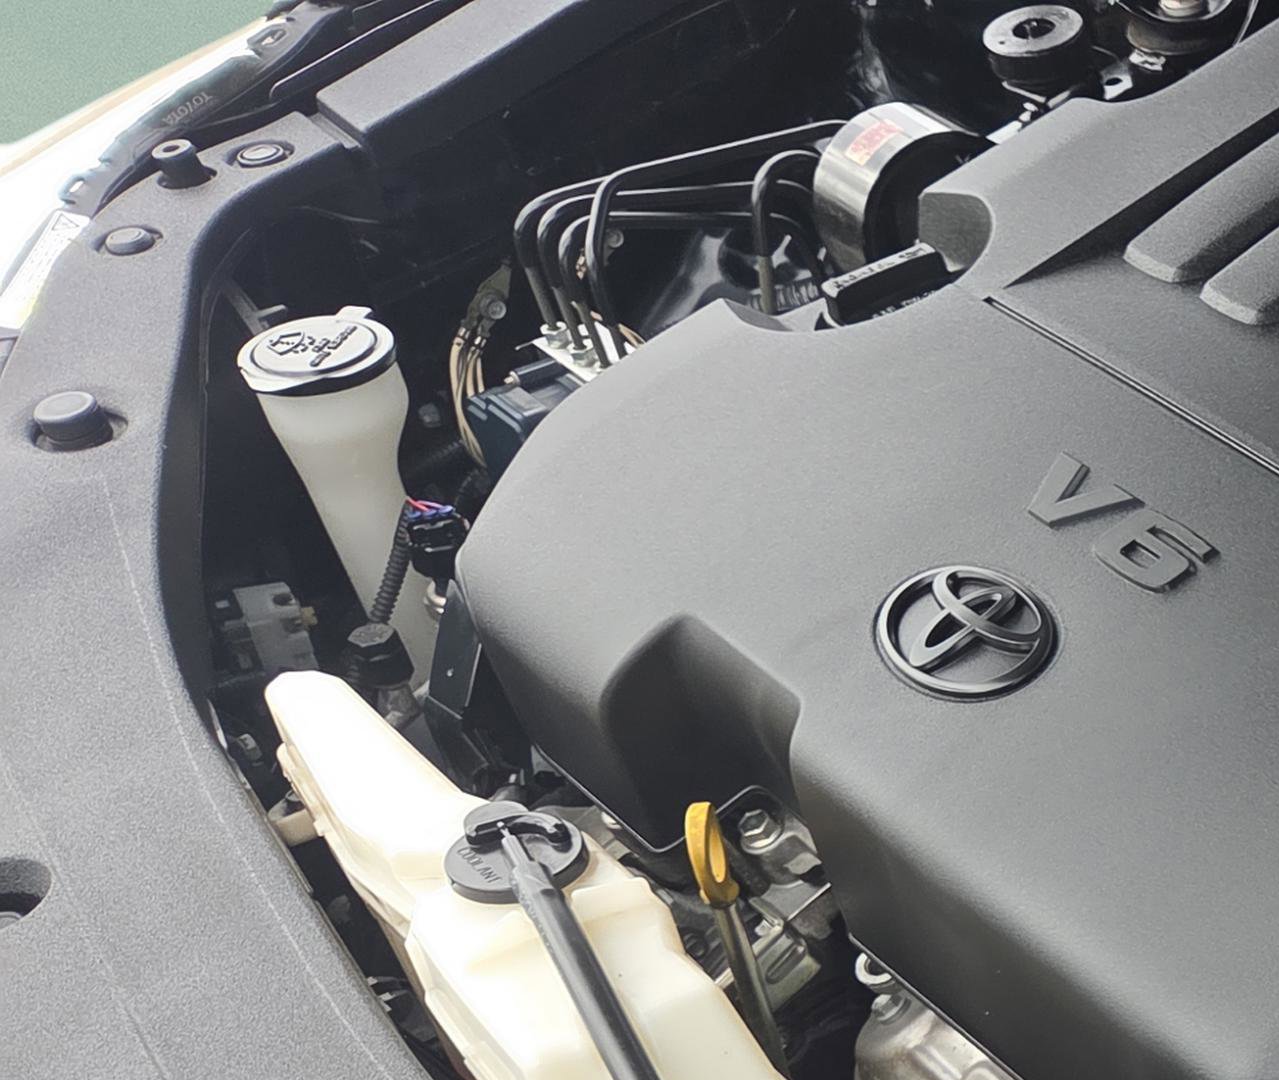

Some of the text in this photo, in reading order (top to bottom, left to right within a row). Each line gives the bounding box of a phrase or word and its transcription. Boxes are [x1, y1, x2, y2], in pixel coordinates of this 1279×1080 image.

[161, 91, 213, 127] TOYOTA
[1027, 449, 1220, 595] V6
[456, 846, 502, 882] COOLANT
